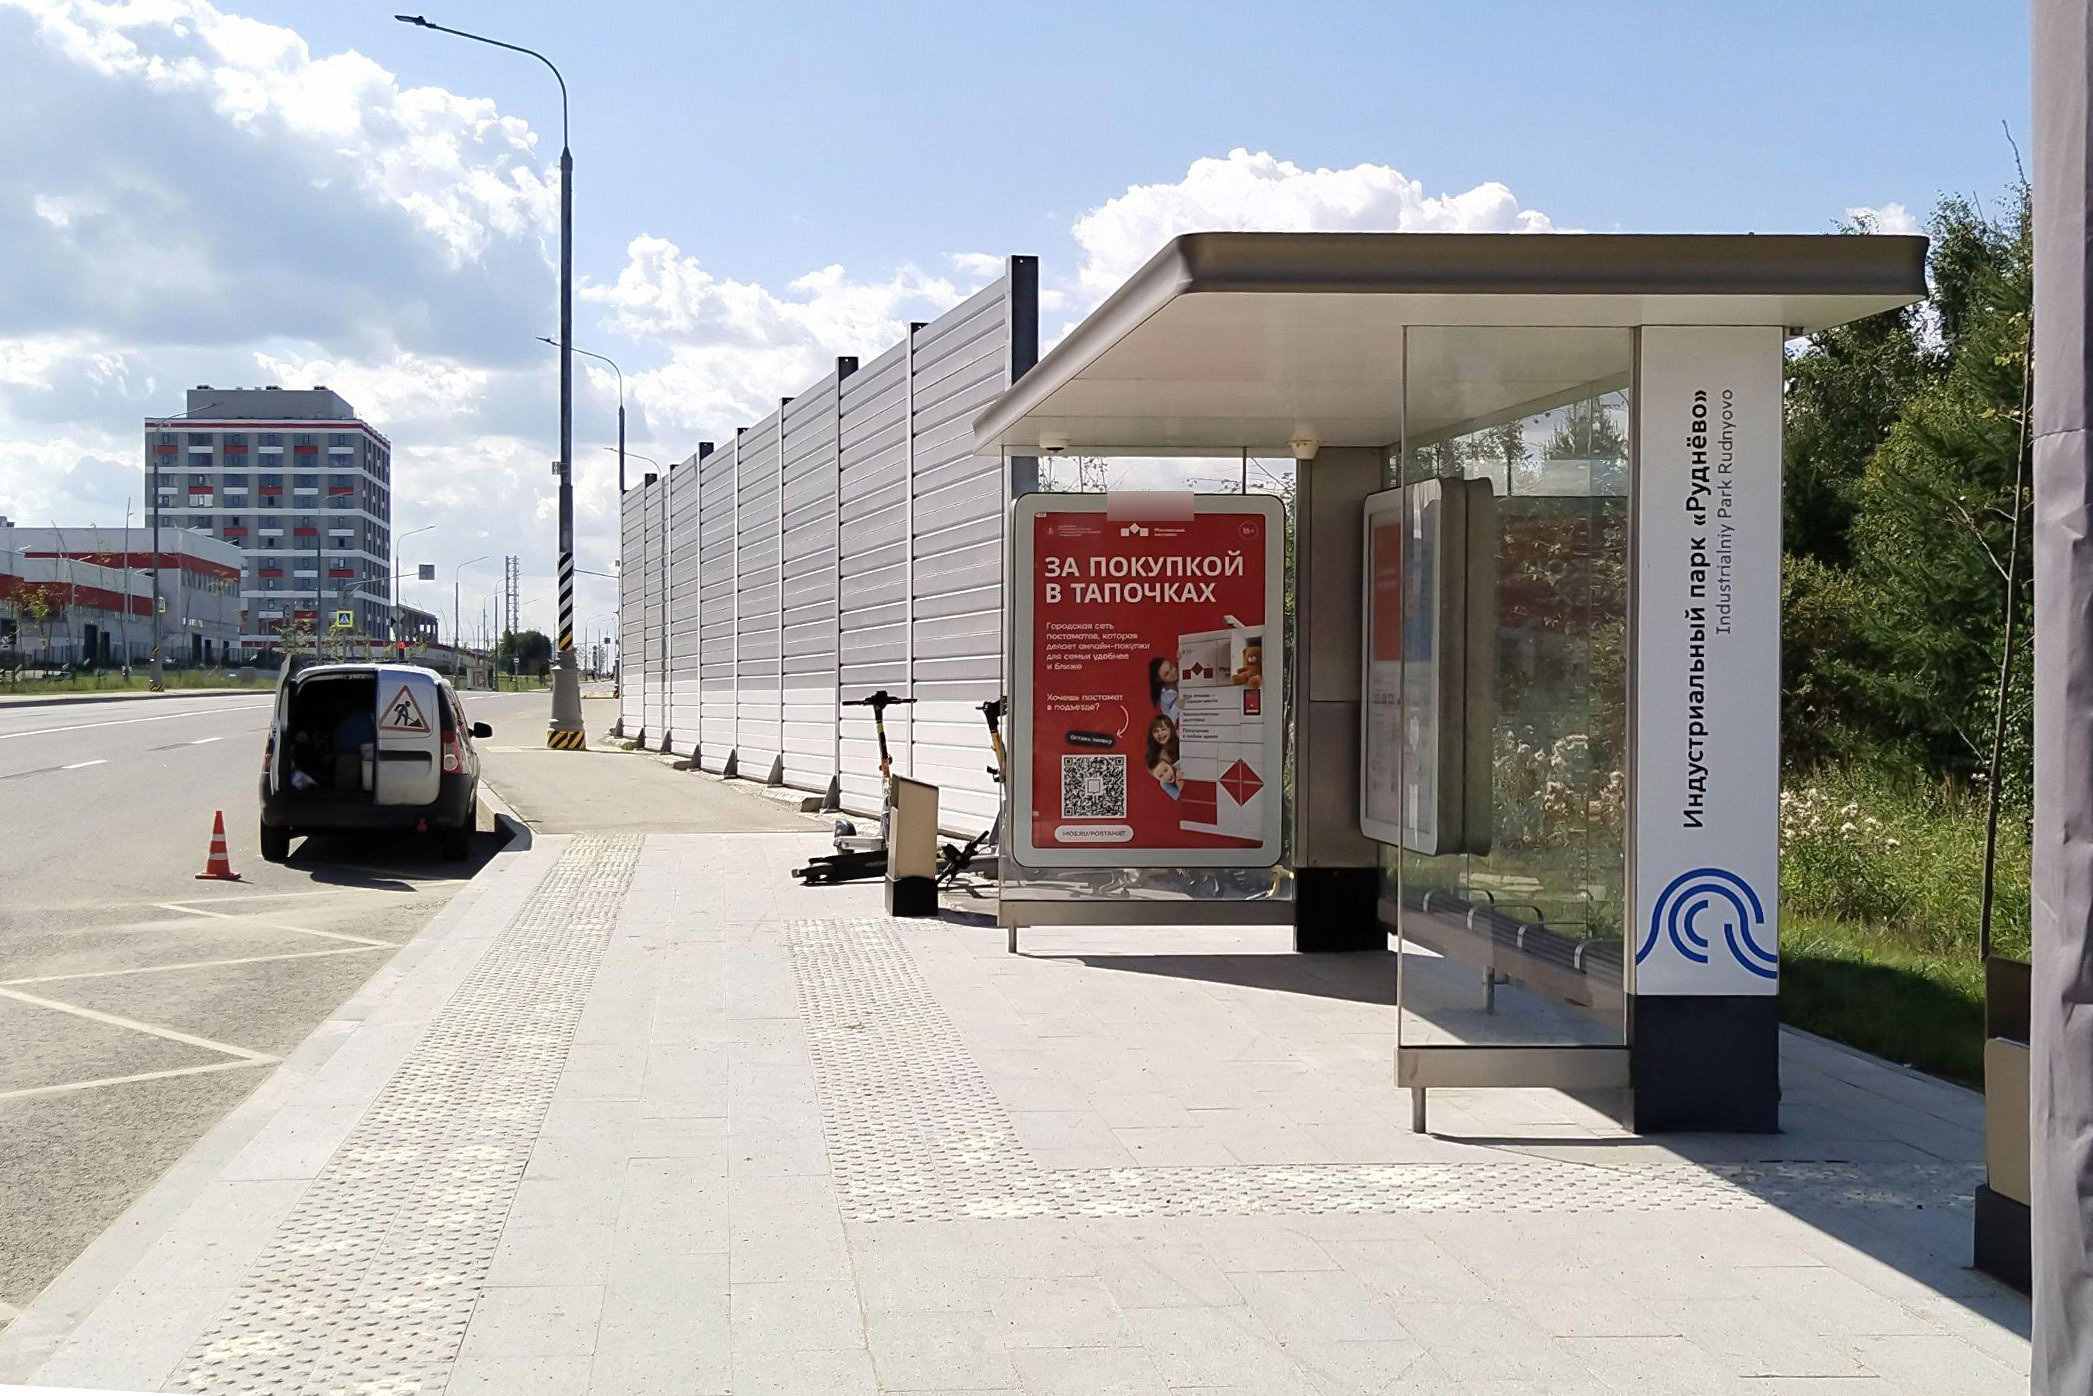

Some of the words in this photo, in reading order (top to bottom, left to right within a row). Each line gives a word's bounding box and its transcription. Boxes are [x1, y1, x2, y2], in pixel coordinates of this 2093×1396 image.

[1718, 389, 1737, 475] Rudnyovo
[1685, 390, 1711, 526] «Руднёво»
[1717, 479, 1733, 519] Park
[1045, 556, 1080, 577] ЗА
[1089, 549, 1244, 577] ПОКУПКОЙ
[1688, 537, 1710, 599] парк
[1715, 524, 1735, 636] Industrialniy
[1046, 583, 1062, 603] В
[1071, 582, 1217, 603] ТАПОЧКАХ
[1046, 622, 1093, 631] Городская
[1102, 633, 1139, 641] которая
[1046, 643, 1077, 651] делает
[1093, 652, 1130, 661] удобнее
[1054, 662, 1083, 670] ближе
[1047, 693, 1080, 701] Хочешь
[1054, 702, 1100, 712] подъезде?
[1683, 606, 1709, 829] Индустриальный
